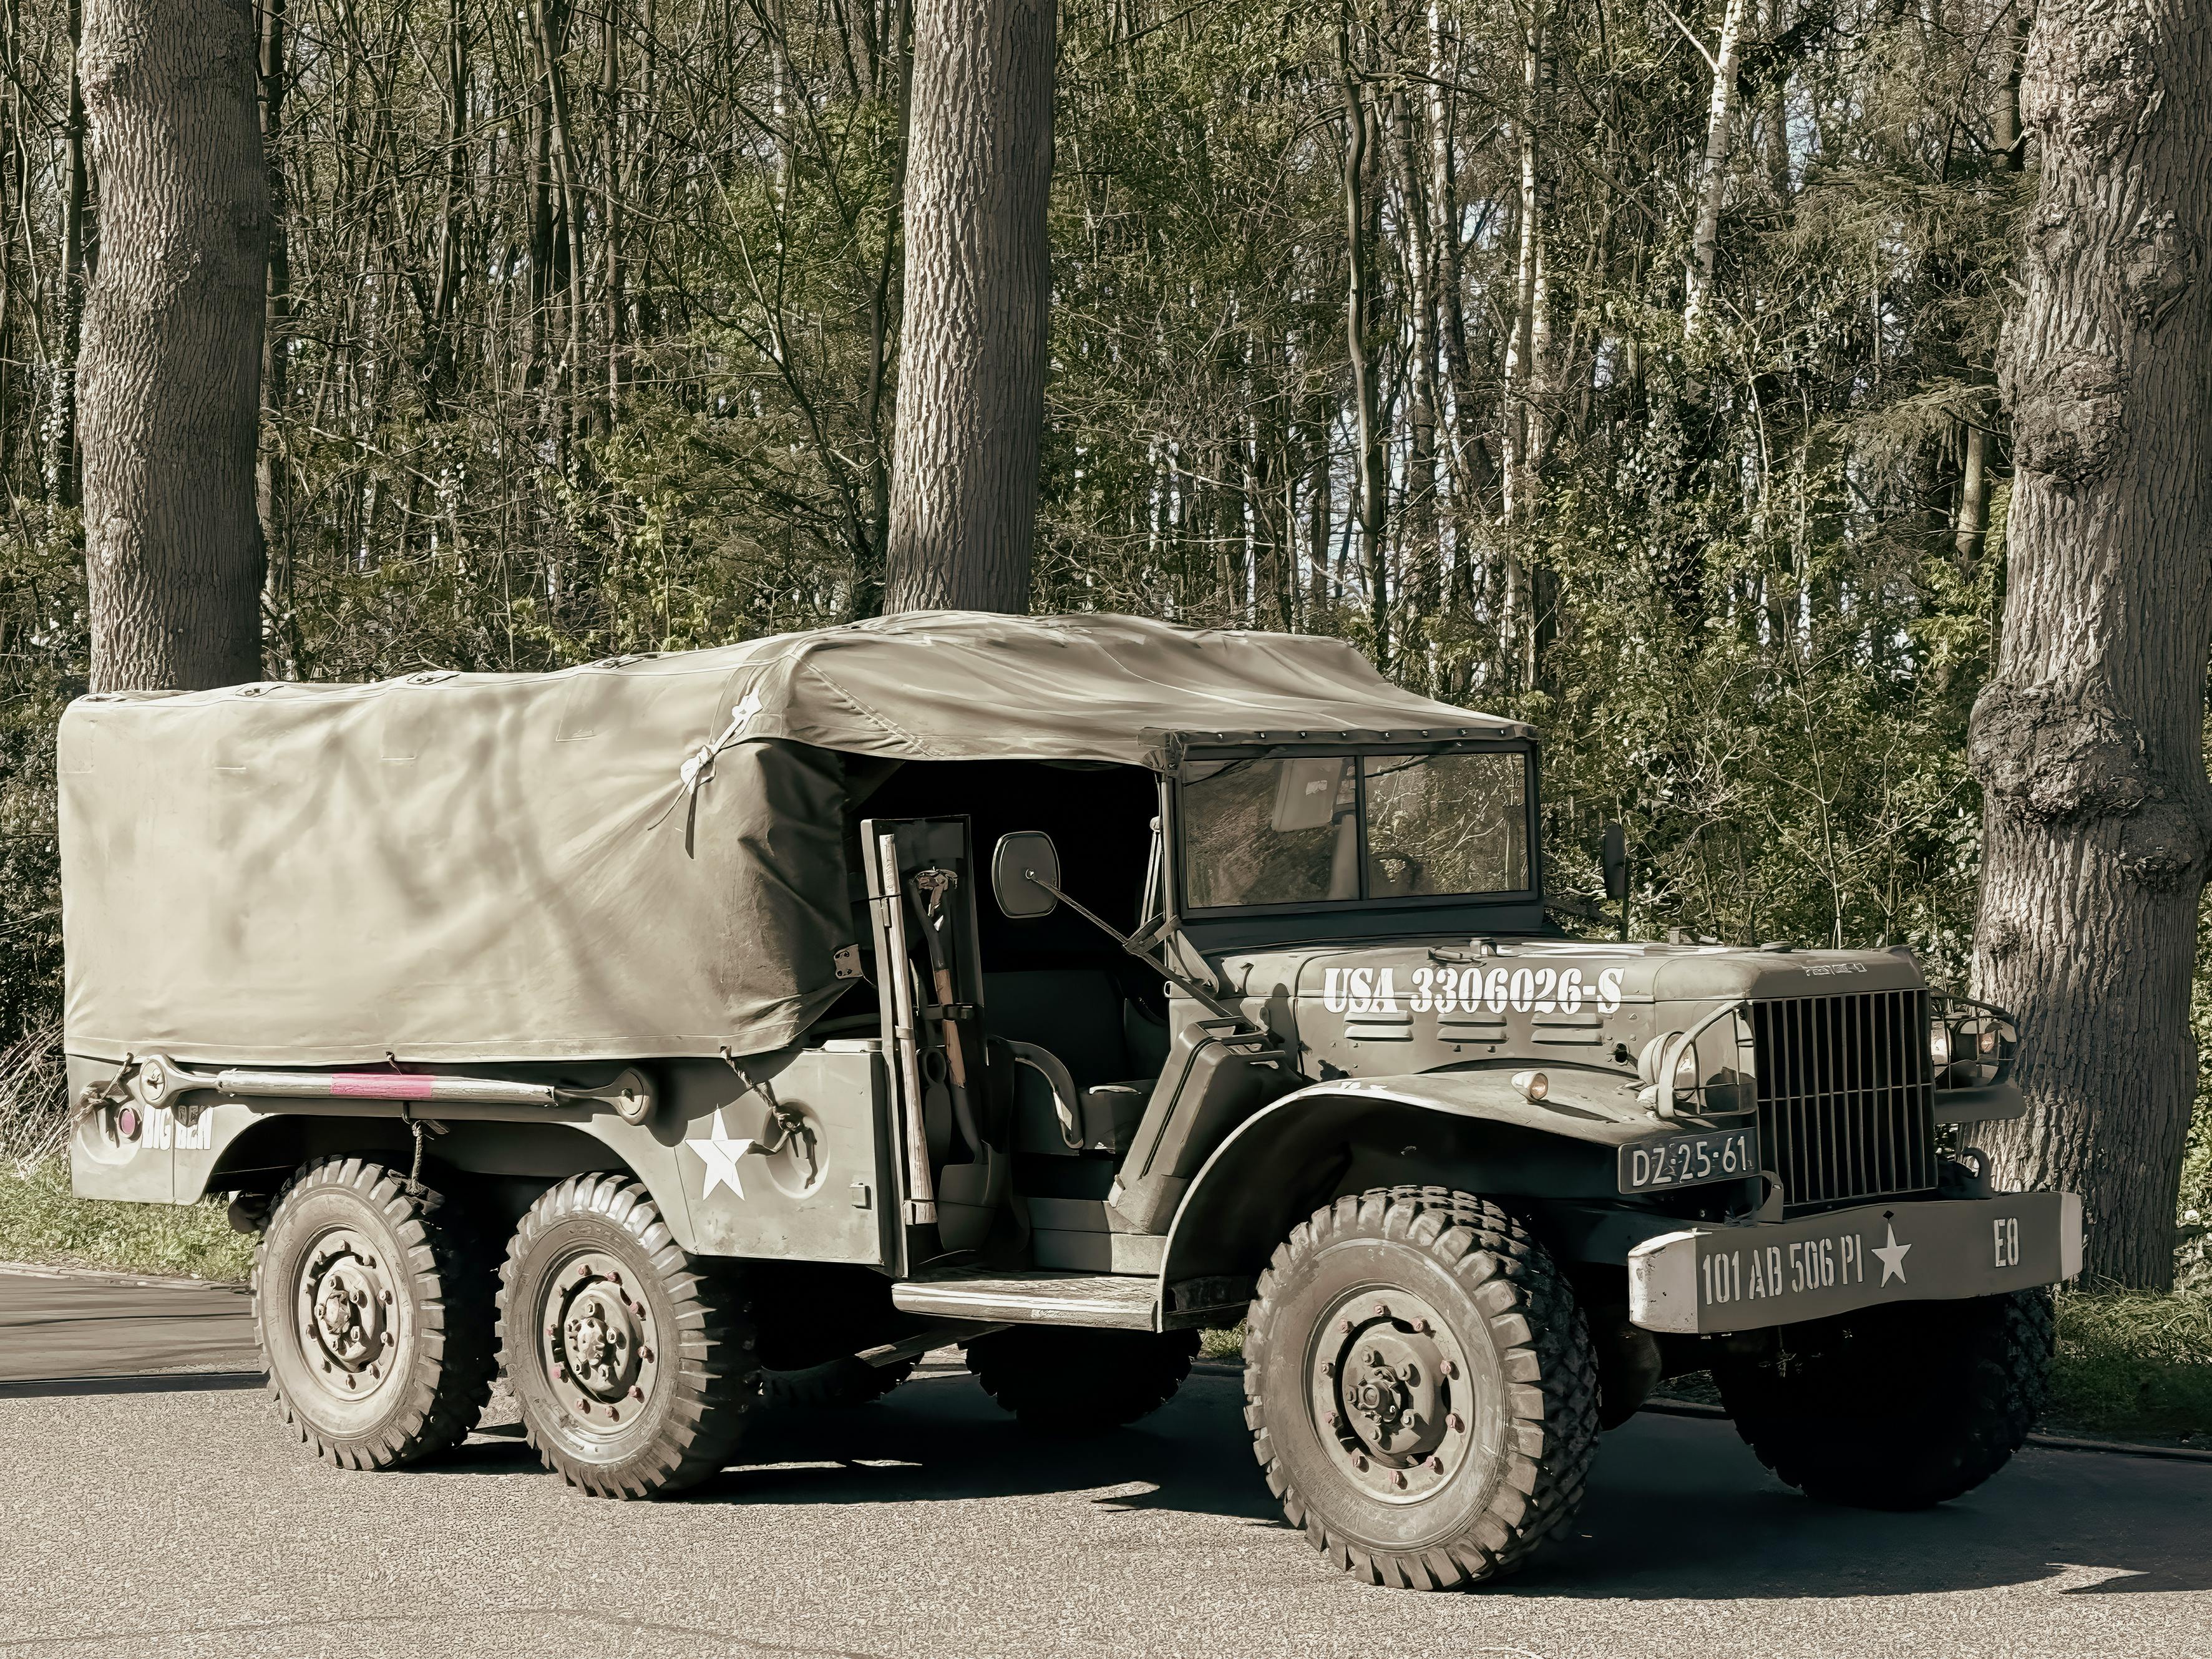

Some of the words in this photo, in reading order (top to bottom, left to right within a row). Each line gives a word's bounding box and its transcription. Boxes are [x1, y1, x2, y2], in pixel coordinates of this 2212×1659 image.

[1323, 967, 1398, 1014] USA
[1410, 966, 1625, 1014] 3306026-S
[1702, 1250, 1740, 1305] 101
[1748, 1246, 1783, 1300] AB
[1789, 1238, 1834, 1293] 506
